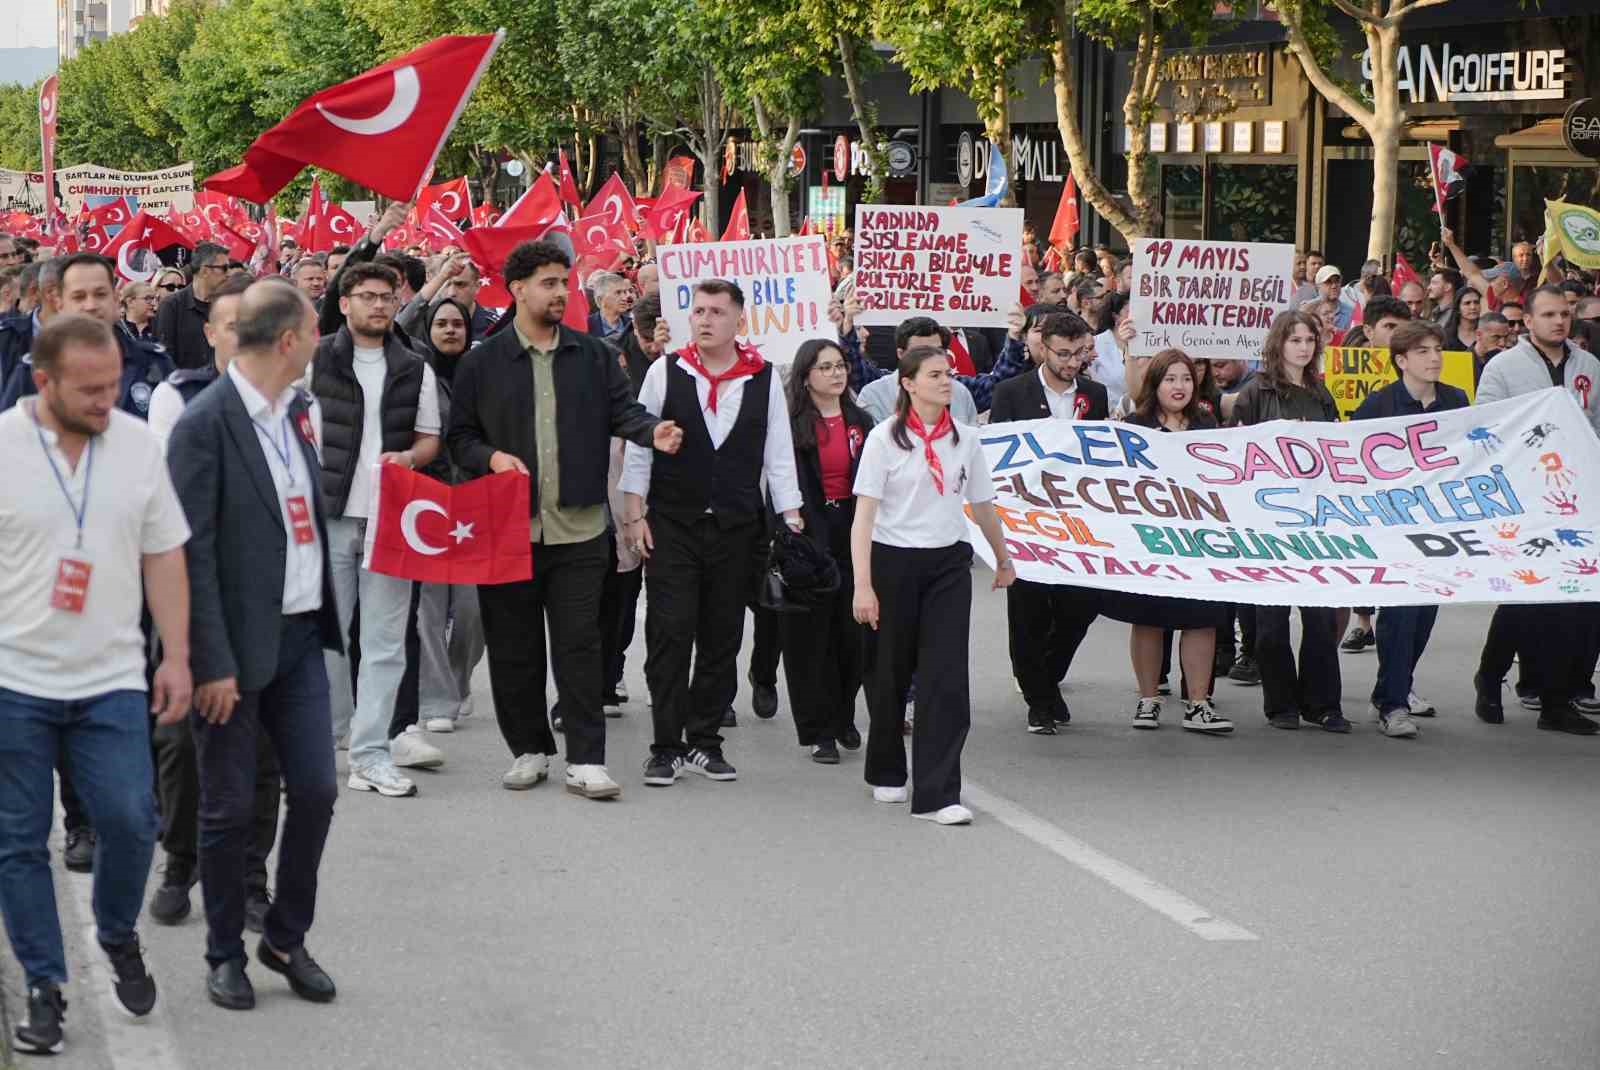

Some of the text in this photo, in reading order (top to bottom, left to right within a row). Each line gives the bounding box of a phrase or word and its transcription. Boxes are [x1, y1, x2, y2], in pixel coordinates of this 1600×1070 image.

[1449, 49, 1565, 92] COIFFURE
[68, 184, 150, 196] CUMHURİYETİ
[108, 173, 120, 181] NE
[861, 211, 939, 232] KADINDA
[1145, 240, 1249, 272] 19 MAYIS
[952, 275, 974, 294] VE
[1140, 271, 1287, 303] BİR TARİH DEĞİL
[949, 294, 999, 312] OLUR.
[1152, 301, 1274, 329] KARAKTERDİR
[1141, 329, 1171, 347] Türk
[980, 420, 1459, 485] ZLER SADECE
[1255, 464, 1525, 528] SAHİPLERİ
[963, 502, 1490, 562] EĞİL BUGÜNÜN DE
